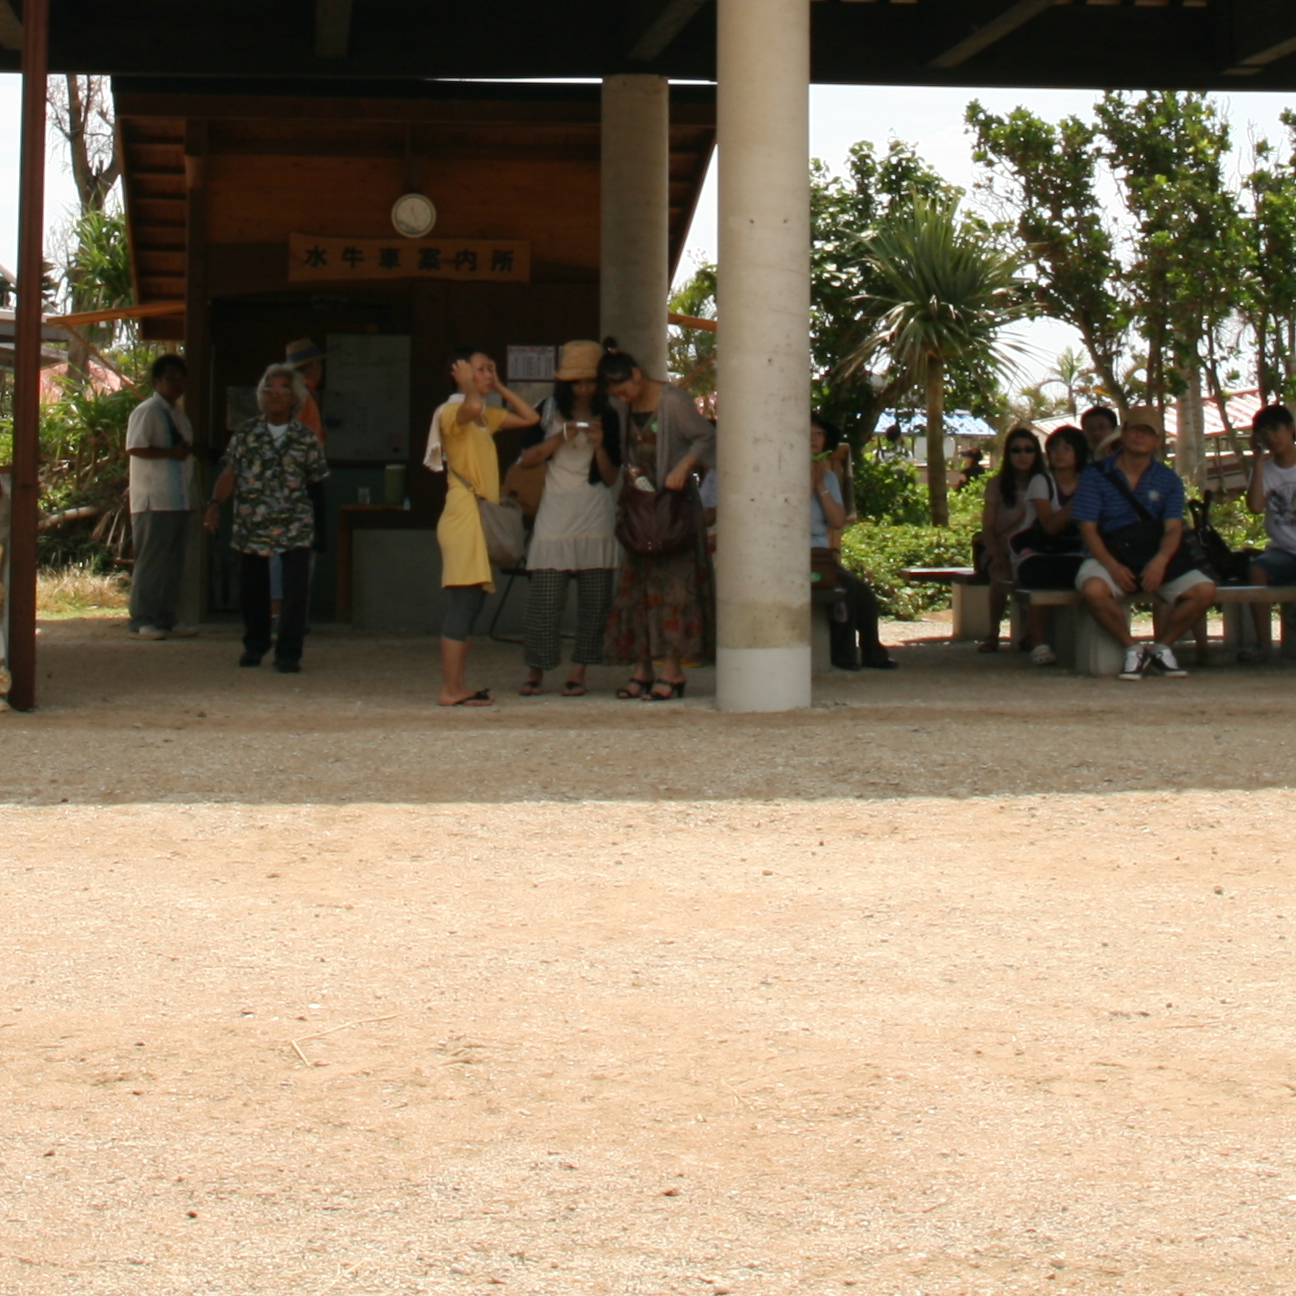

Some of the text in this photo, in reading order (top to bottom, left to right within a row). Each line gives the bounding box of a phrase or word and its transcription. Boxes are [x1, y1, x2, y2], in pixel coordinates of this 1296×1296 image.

[303, 245, 515, 273] 水牛車案内所
